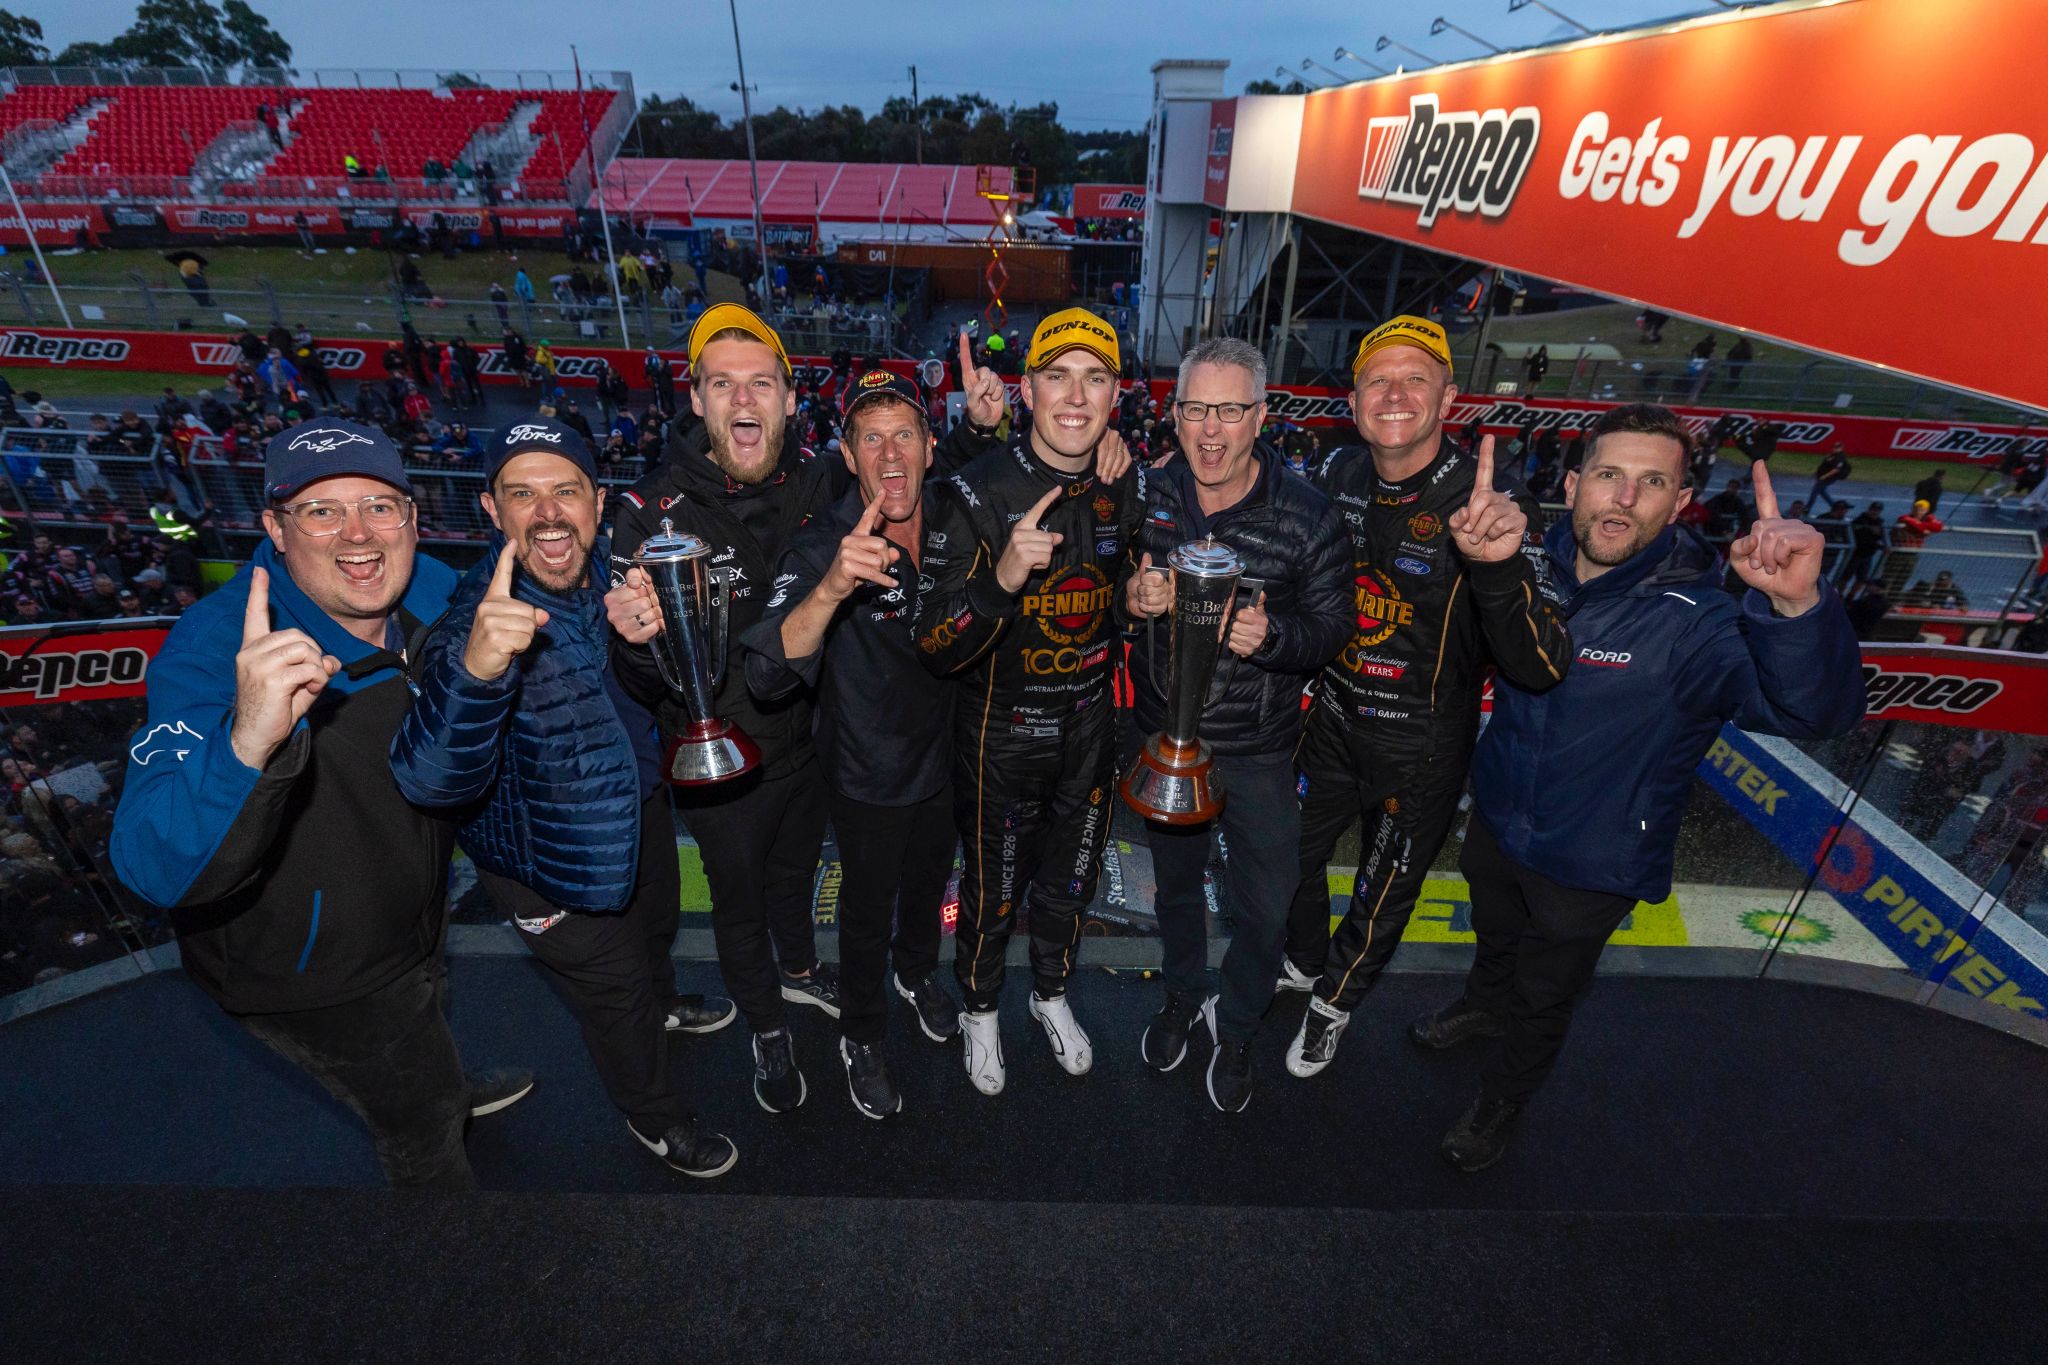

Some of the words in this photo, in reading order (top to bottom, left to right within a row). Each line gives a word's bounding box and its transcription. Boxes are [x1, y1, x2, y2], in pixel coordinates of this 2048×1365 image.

[1391, 94, 1540, 227] Repco
[1559, 111, 1690, 207] Gets
[1678, 134, 1862, 239] you
[1118, 190, 1147, 214] Rep
[29, 216, 55, 232] you
[198, 208, 249, 231] Repco
[517, 217, 536, 229] you
[868, 249, 886, 262] CAI
[1039, 320, 1114, 343] DUNLOP
[1365, 321, 1441, 347] DUNLOP
[6, 331, 130, 363] Repco
[858, 373, 896, 388] PENRITE
[505, 424, 562, 445] Ford
[1431, 453, 1460, 485] HRX
[950, 474, 982, 508] HRX
[1092, 502, 1116, 513] PENRITE
[1343, 509, 1365, 532] PEX
[1407, 518, 1444, 534] PENRITE
[711, 551, 735, 564] adfast
[1099, 542, 1118, 553] Ford
[1400, 541, 1426, 551] RACING
[1022, 583, 1114, 617] PENRITE
[1354, 583, 1415, 626] NRITE
[673, 609, 694, 619] 2025
[1086, 650, 1105, 665] YEARS
[1357, 650, 1410, 669] Celebrating
[1579, 647, 1632, 663] FORD
[0, 647, 149, 699] epco
[1366, 665, 1394, 677] YEARS
[1024, 684, 1066, 693] AUSTRALIAN
[1374, 690, 1400, 700] OWNED
[1377, 709, 1410, 719] GARTH
[1704, 737, 1790, 816] RTEK
[1080, 807, 1100, 847] SINCE
[1374, 812, 1395, 851] SINCE
[1002, 834, 1017, 862] 1926
[1074, 848, 1091, 877] 1926
[1365, 851, 1381, 880] 1926
[1001, 865, 1015, 901] SINCE
[1105, 846, 1125, 905] Steadfast
[1862, 875, 2046, 1013] PIRTEK
